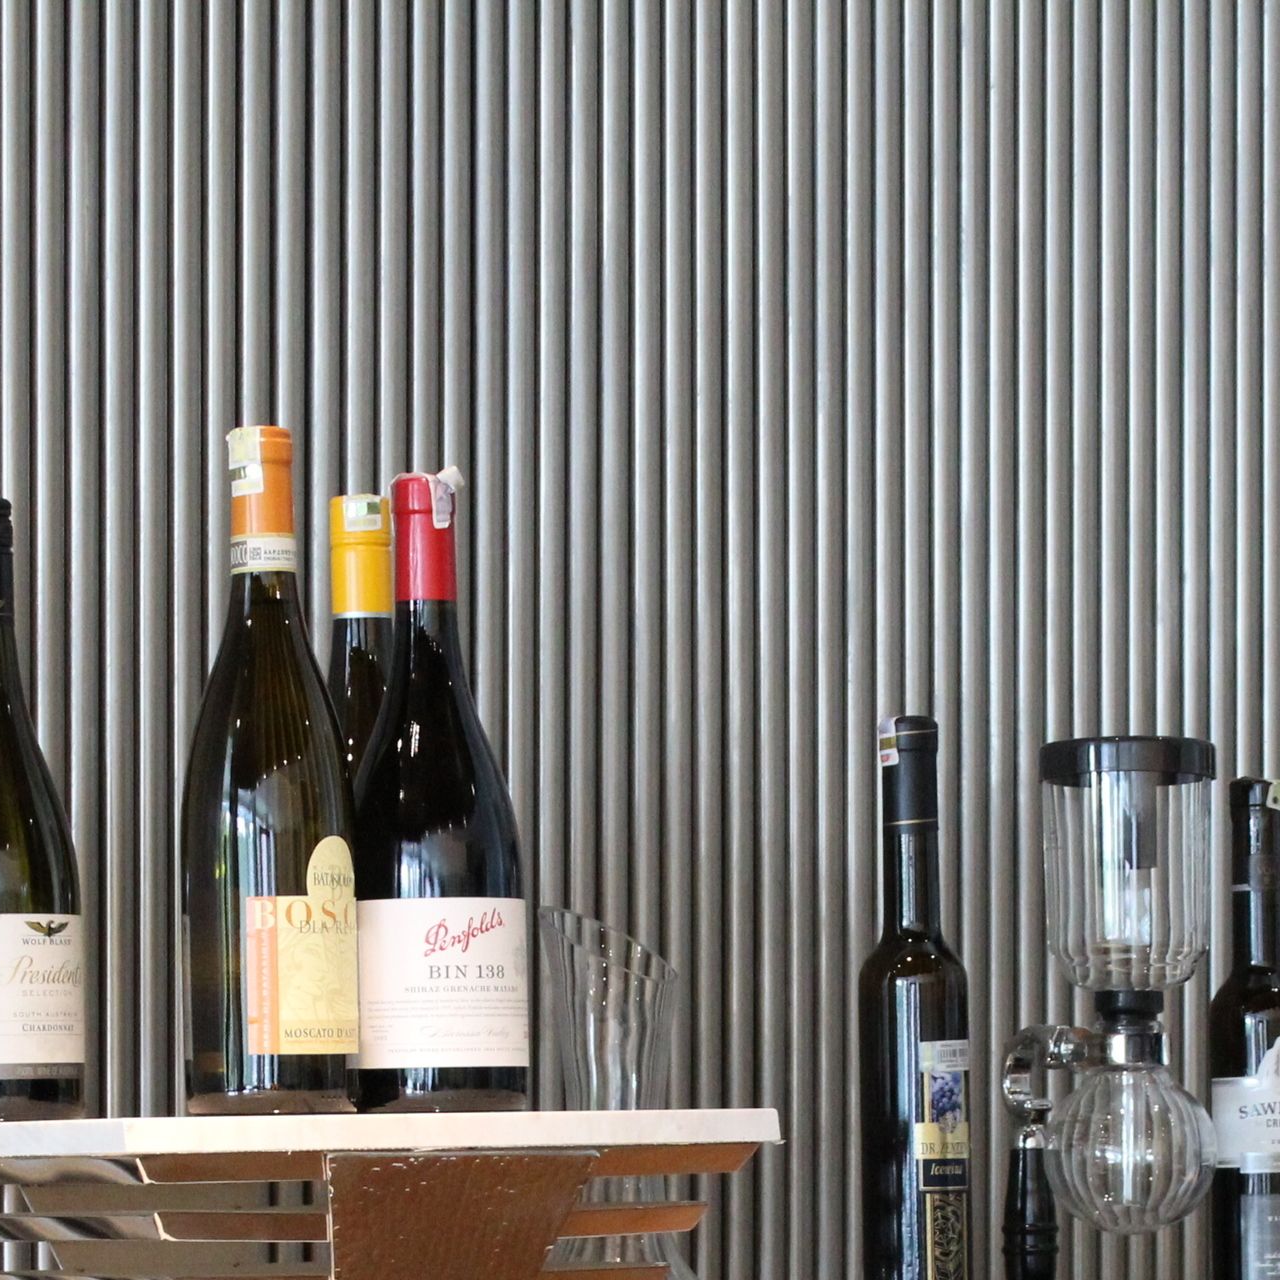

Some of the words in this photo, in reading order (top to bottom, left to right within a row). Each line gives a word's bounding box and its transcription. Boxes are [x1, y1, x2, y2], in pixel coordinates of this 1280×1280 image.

[424, 907, 505, 957] Penfolds
[22, 938, 46, 946] WOLF
[429, 965, 468, 979] BIN
[475, 965, 504, 979] 138
[284, 1028, 333, 1039] MOSCATO
